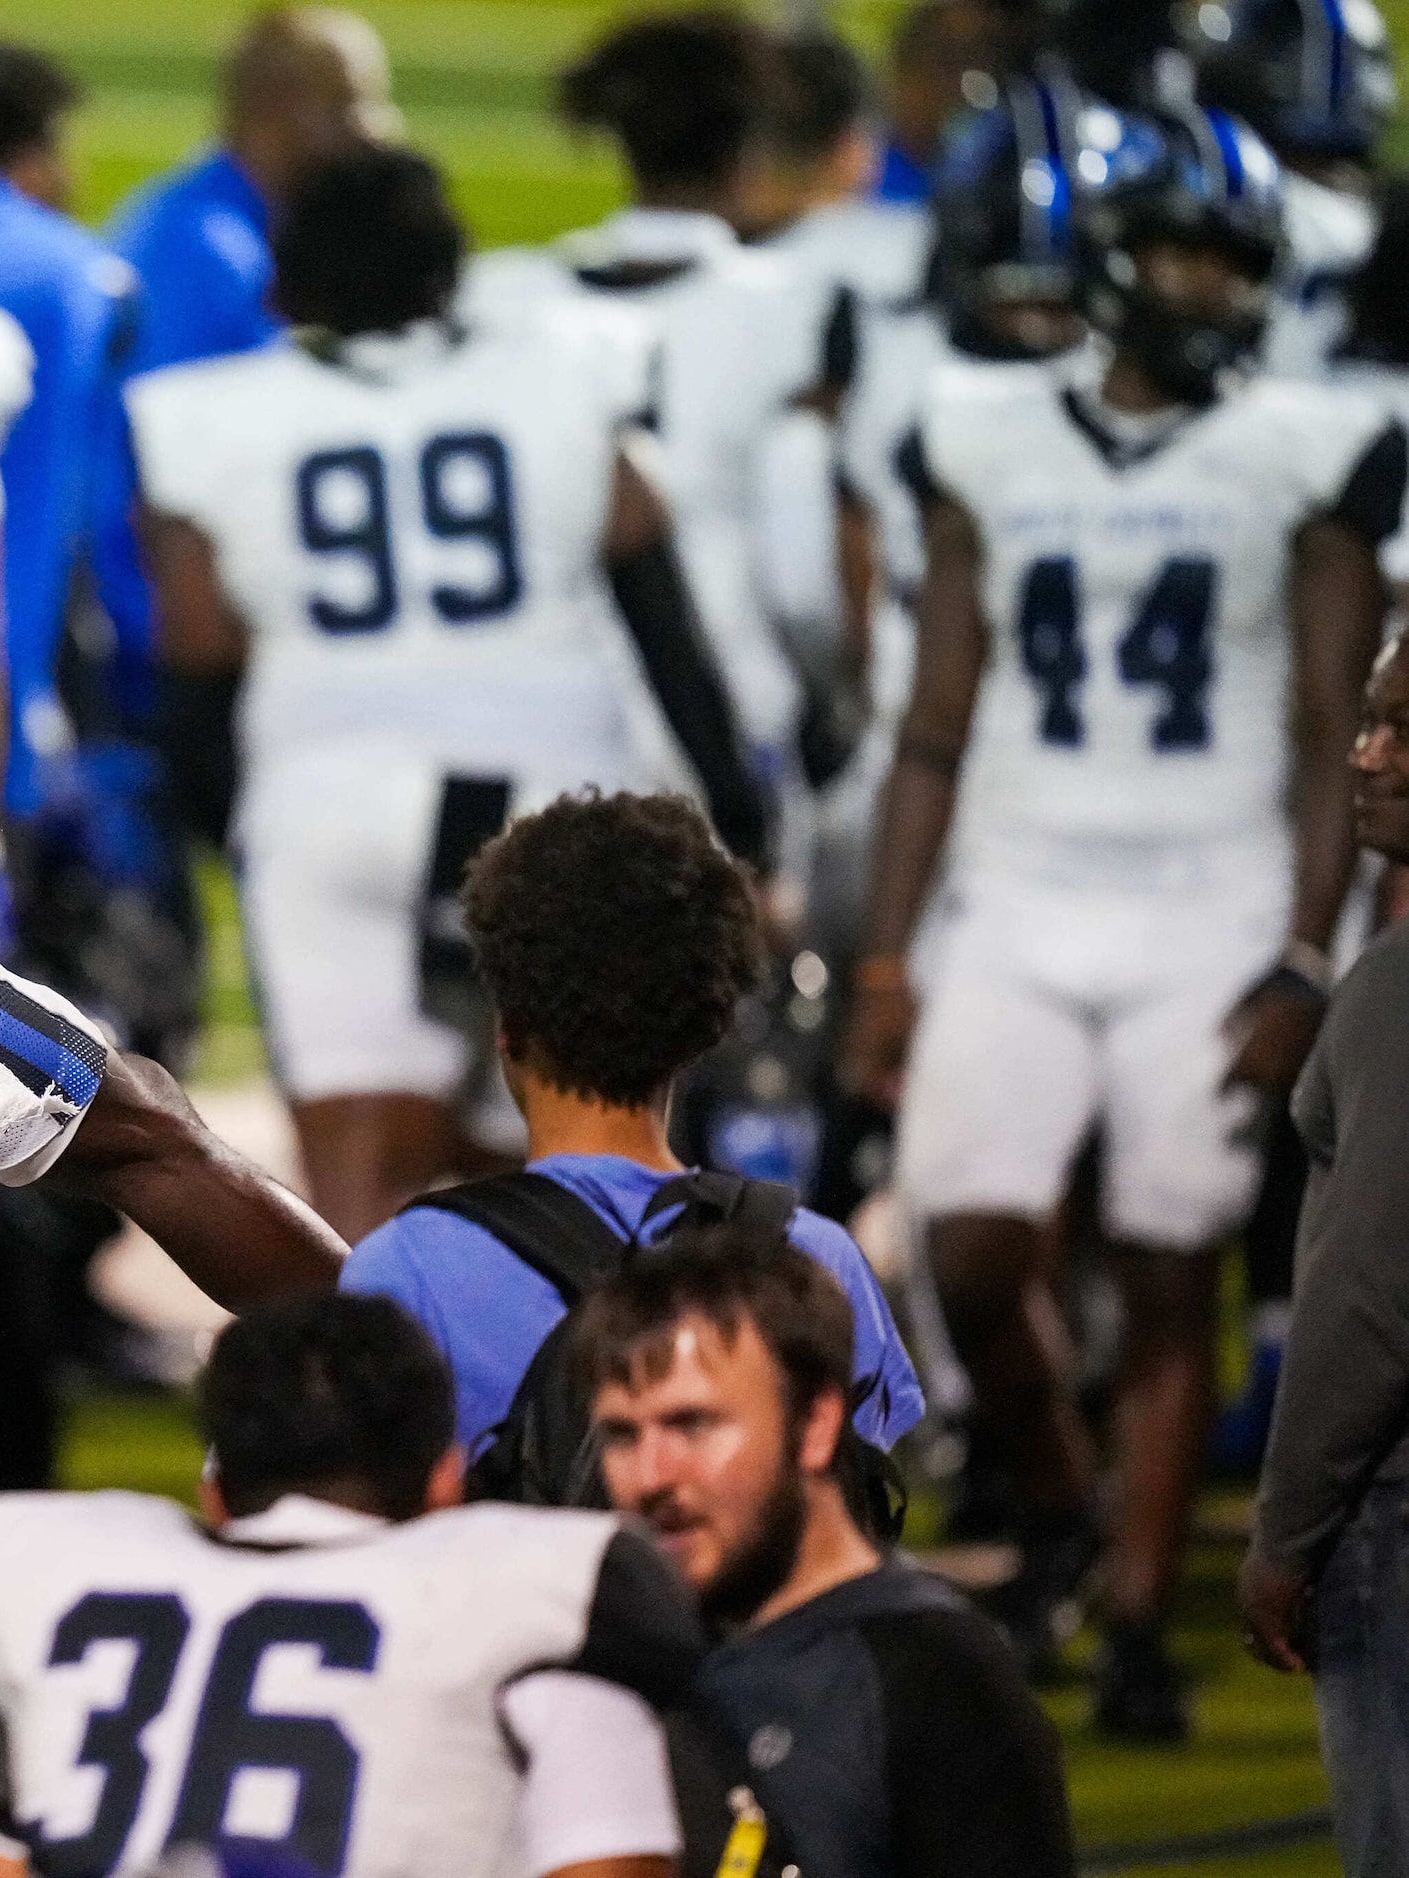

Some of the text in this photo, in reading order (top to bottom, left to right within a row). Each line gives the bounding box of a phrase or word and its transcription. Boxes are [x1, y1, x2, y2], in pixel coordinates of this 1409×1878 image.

[297, 432, 519, 633] 99
[1018, 554, 1217, 754] 44
[28, 1590, 382, 1878] 36
